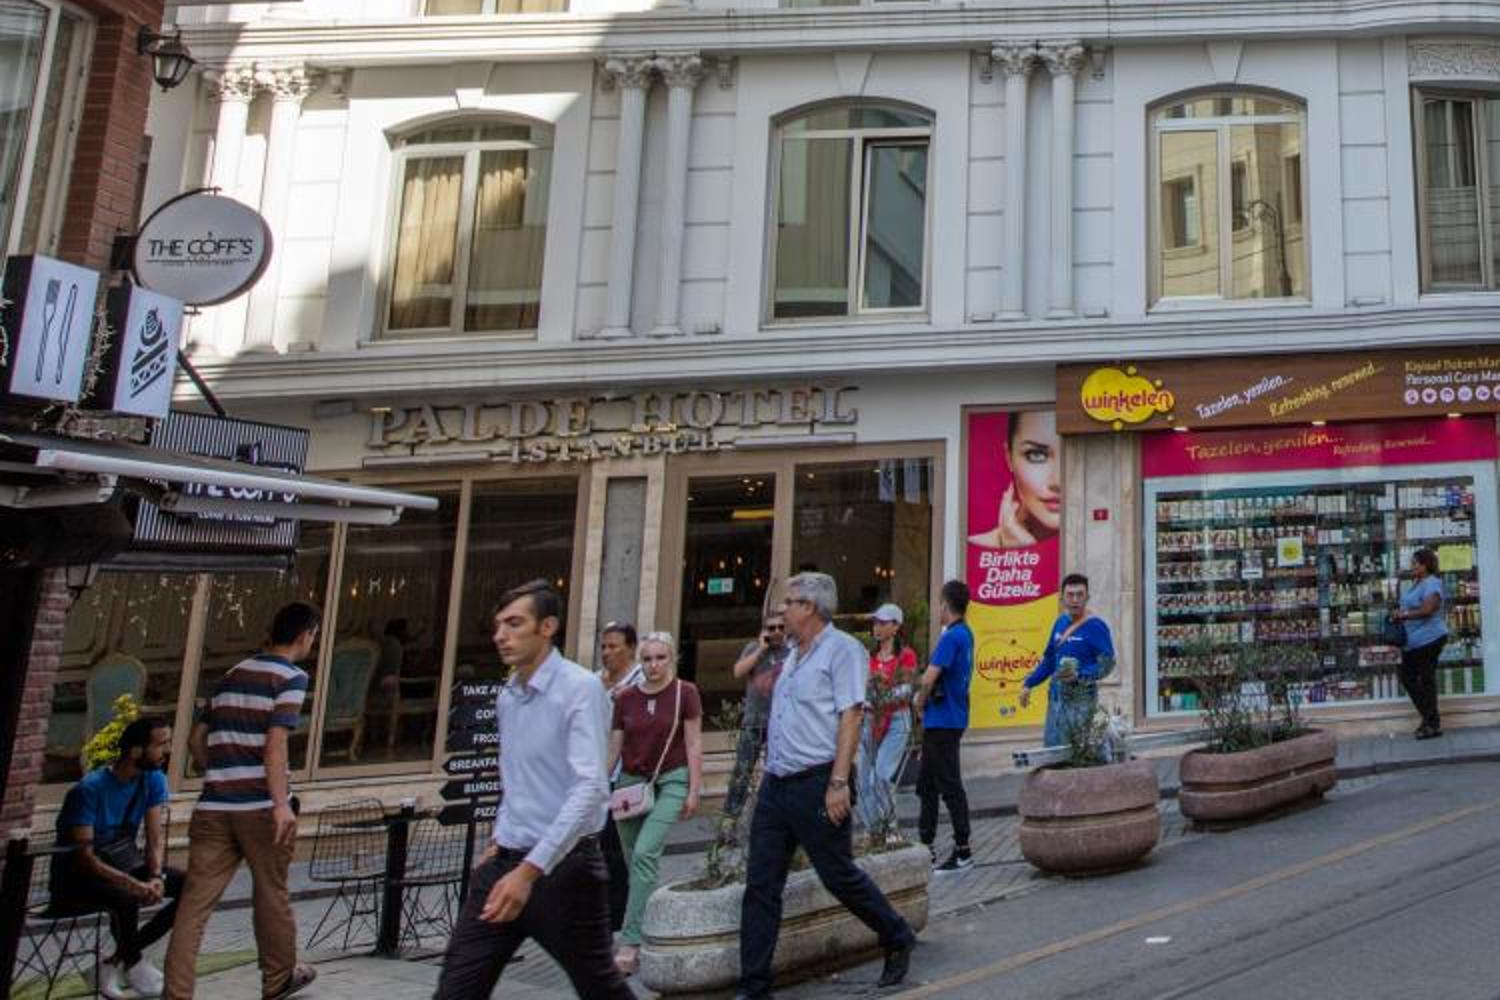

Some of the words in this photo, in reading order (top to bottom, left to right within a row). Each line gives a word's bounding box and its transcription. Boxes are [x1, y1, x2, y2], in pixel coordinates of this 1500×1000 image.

[149, 239, 184, 257] THE
[1406, 372, 1453, 385] Personal
[1454, 371, 1479, 383] Care
[1084, 388, 1171, 412] winkelen
[368, 400, 593, 449] PALDE
[631, 386, 860, 432] HOTEL
[979, 551, 1040, 568] Birlikte
[986, 567, 1032, 582] Daha
[978, 582, 1041, 599] Güzeliz
[462, 685, 486, 696] TAKE
[473, 733, 500, 744] FROZ
[449, 757, 499, 771] BREAKFA
[464, 781, 501, 793] BURGE
[474, 806, 498, 819] PIZZ
